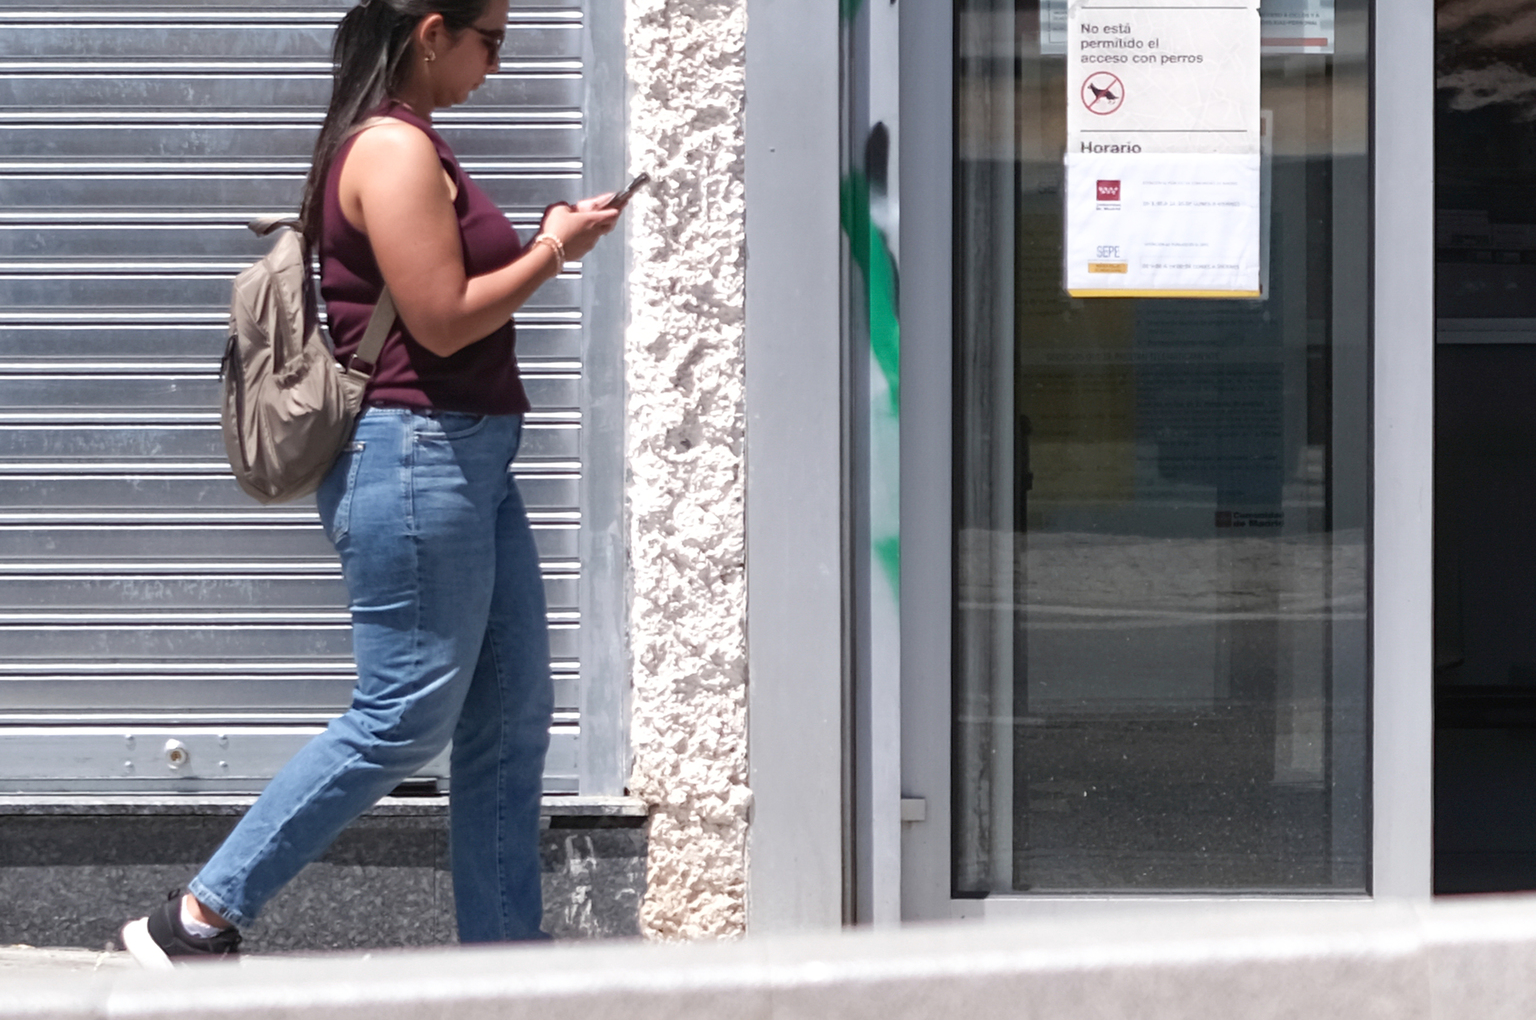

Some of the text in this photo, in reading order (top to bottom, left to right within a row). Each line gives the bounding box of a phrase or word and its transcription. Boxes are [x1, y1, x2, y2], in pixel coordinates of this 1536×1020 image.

[1080, 23, 1131, 34] No está
[1080, 38, 1160, 50] permitido el
[1080, 55, 1204, 65] acceso con perros
[1080, 140, 1142, 154] Horario
[1096, 246, 1120, 258] SEPE
